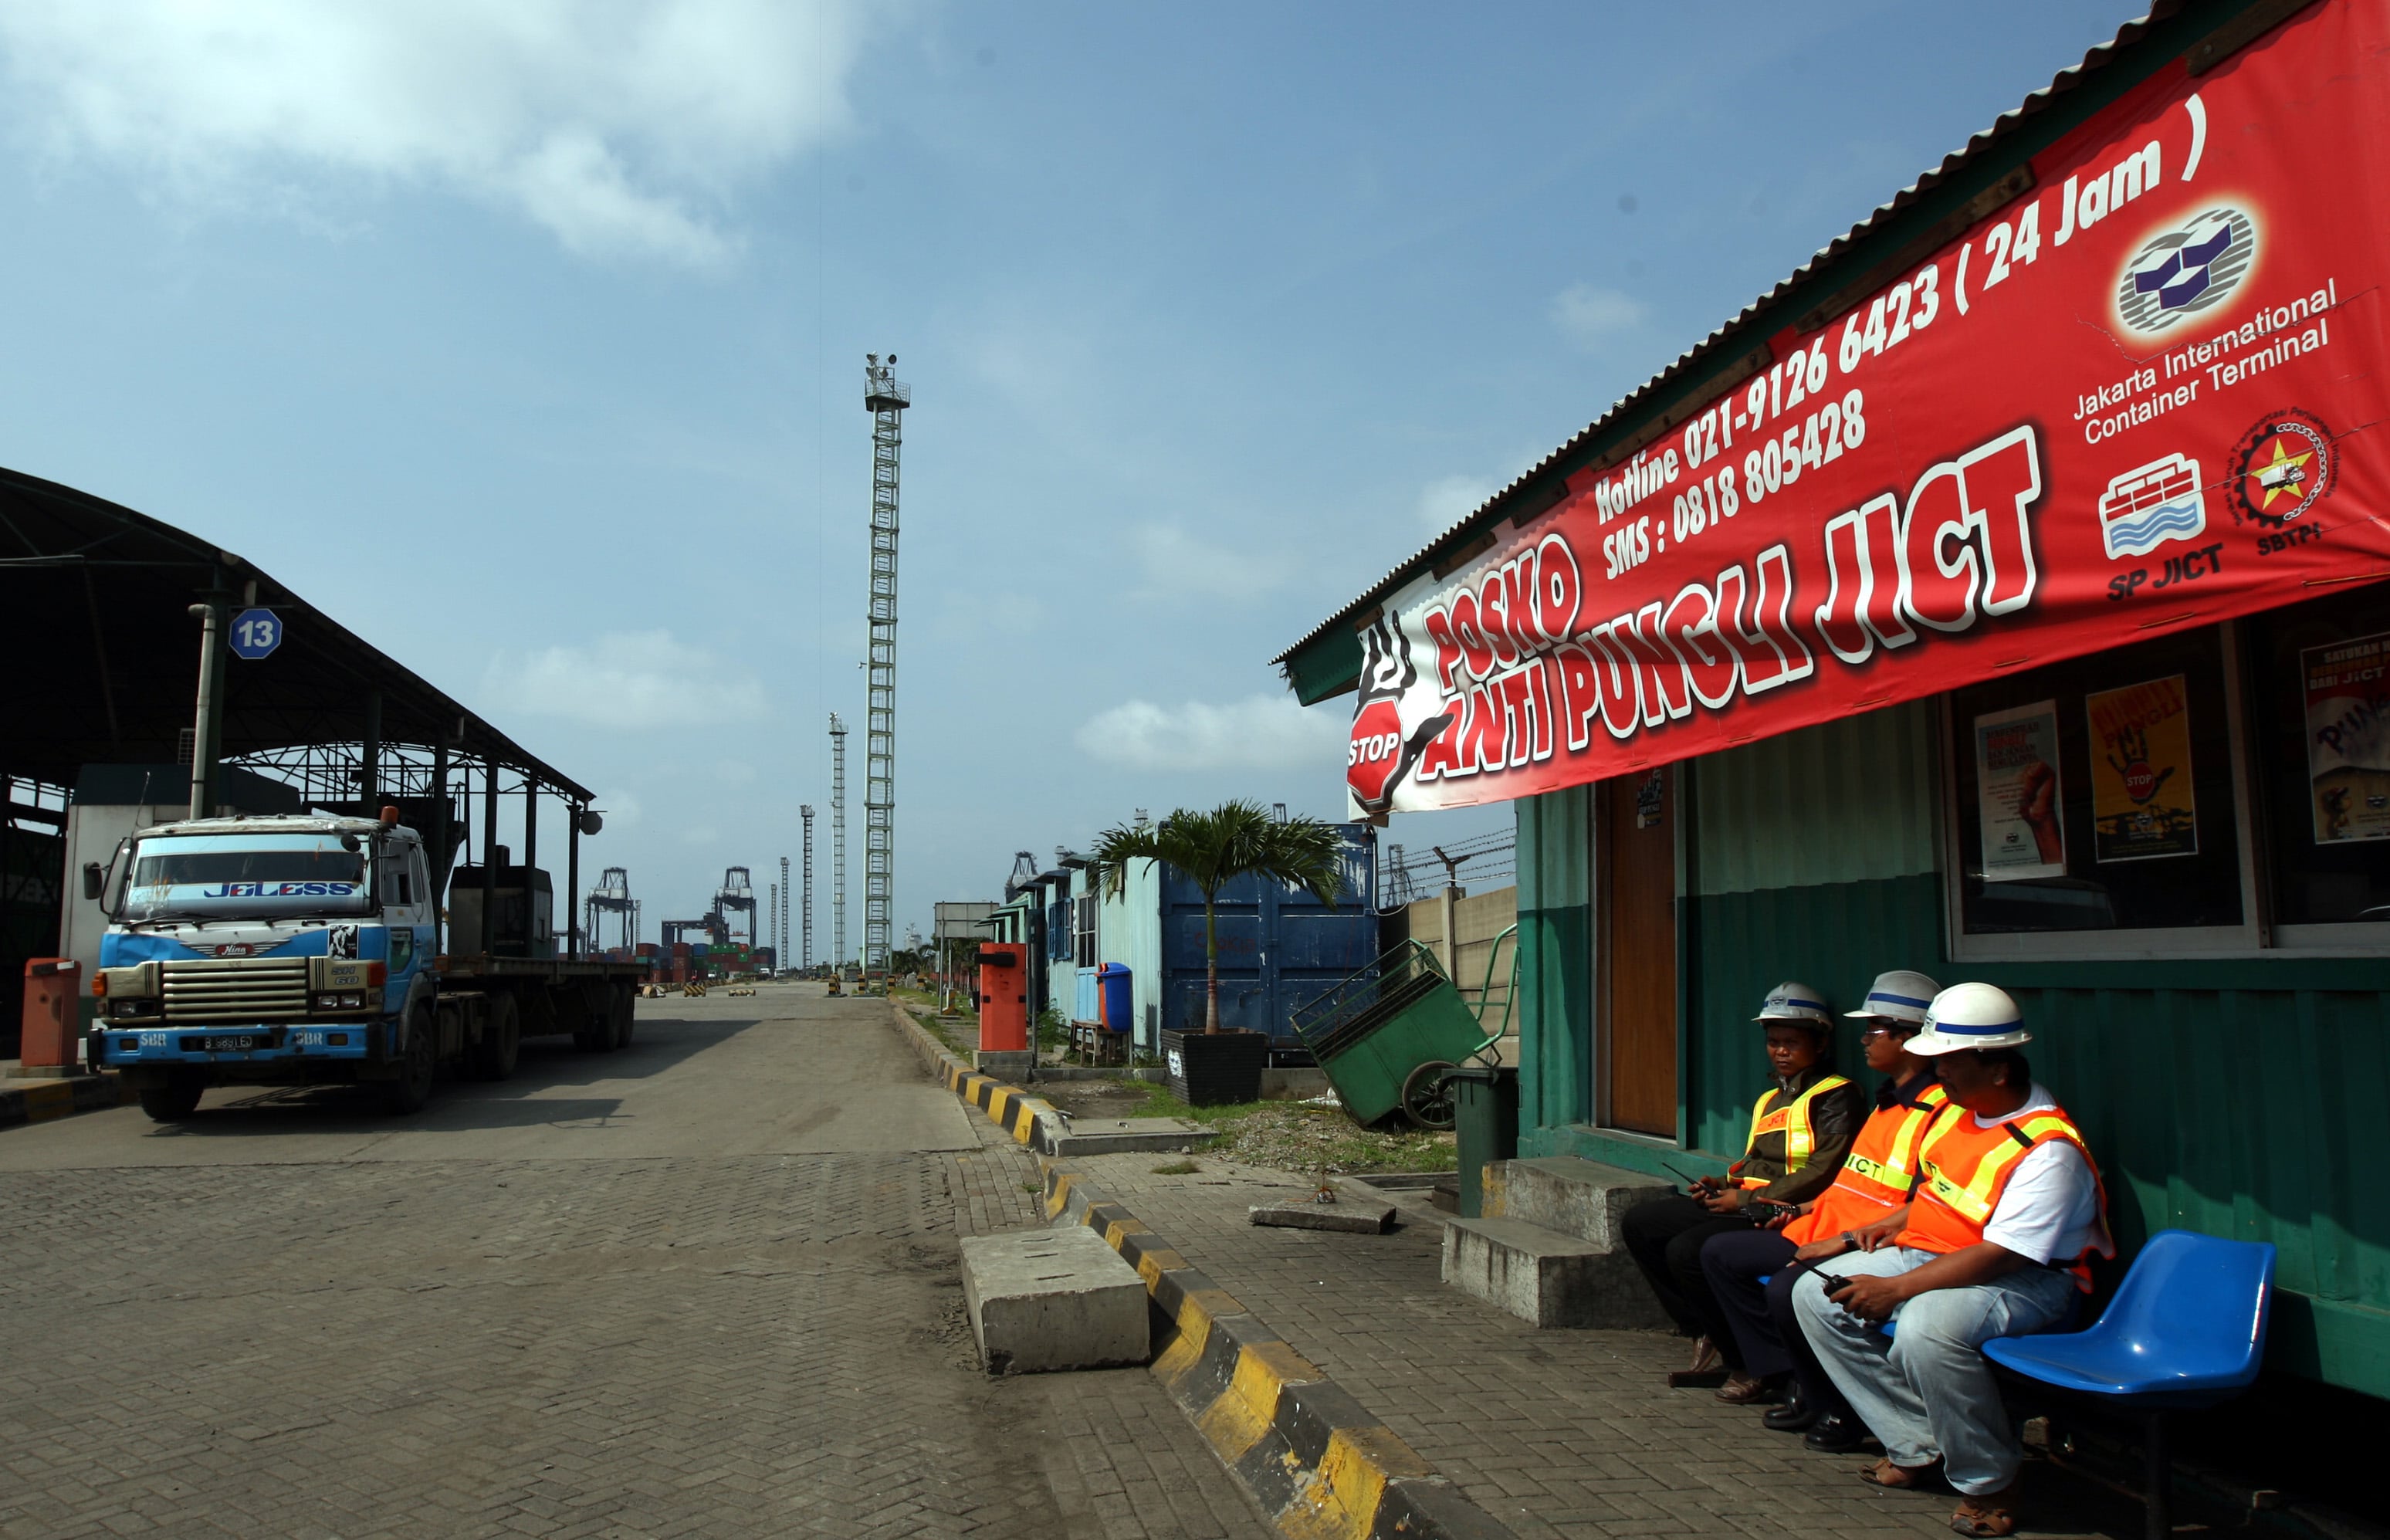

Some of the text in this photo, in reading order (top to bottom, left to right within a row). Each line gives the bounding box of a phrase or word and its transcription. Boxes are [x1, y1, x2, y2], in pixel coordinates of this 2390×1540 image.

[1595, 448, 1679, 525] Hotline
[1684, 334, 1828, 469] 021-9126
[1839, 263, 1939, 374] 6423
[1983, 199, 2041, 292] 24
[2053, 140, 2161, 246] Jam
[2181, 93, 2206, 181] )
[2073, 277, 2338, 421] Jakarta International
[2084, 317, 2329, 445] Container Terminal
[1603, 515, 1650, 580] SMS
[1673, 465, 1739, 543] 0818
[1744, 388, 1866, 504] 805428
[2256, 521, 2322, 557] SBTPI
[2107, 542, 2225, 602] SP JICT
[1415, 423, 2042, 783] ANTI PUNGLI JICT
[1424, 533, 1581, 696] POSKO
[237, 620, 274, 648] 13
[2309, 674, 2339, 691] DARI
[1348, 732, 1400, 767] STOP
[2126, 773, 2152, 787] STOP
[140, 1033, 167, 1048] SBR
